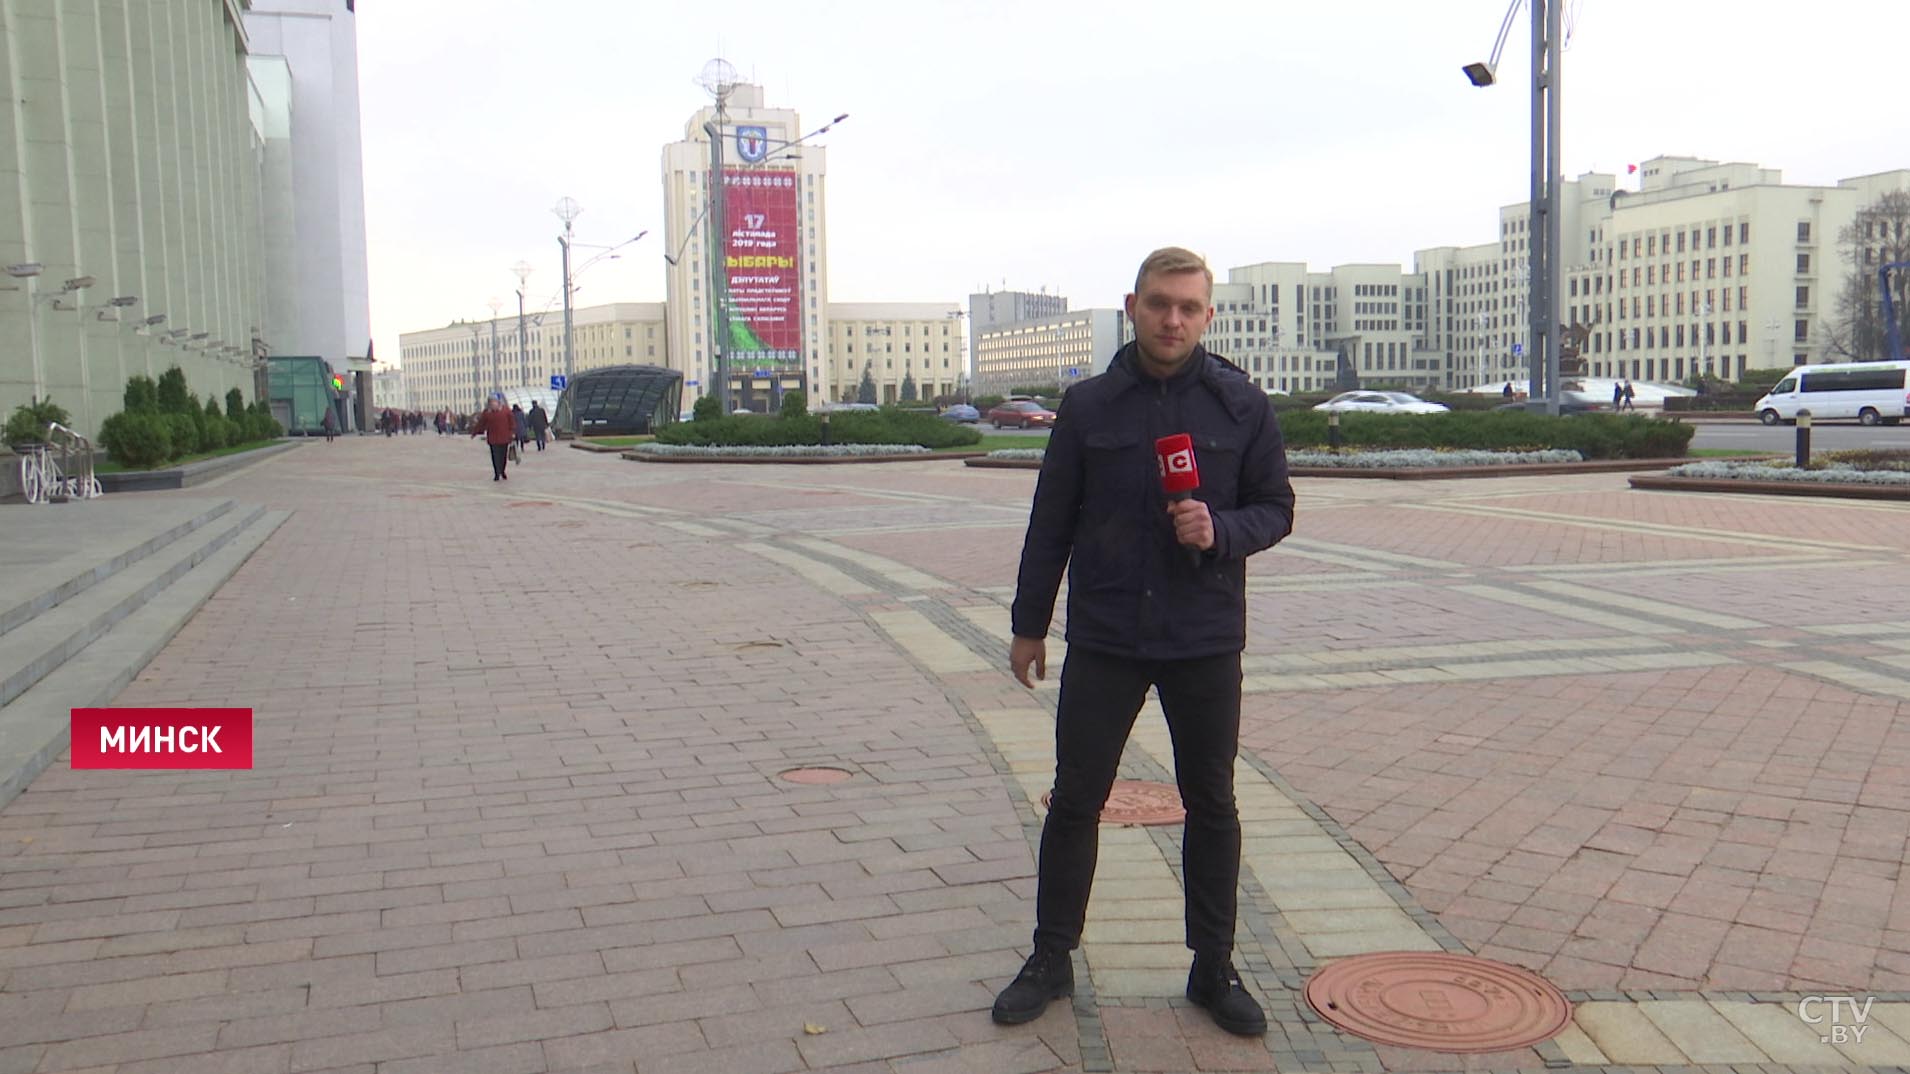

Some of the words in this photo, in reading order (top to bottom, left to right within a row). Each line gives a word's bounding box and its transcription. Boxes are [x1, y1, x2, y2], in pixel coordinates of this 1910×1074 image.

[744, 214, 765, 229] 17
[732, 239, 754, 247] 2019
[725, 256, 794, 268] ЫБАРЫ
